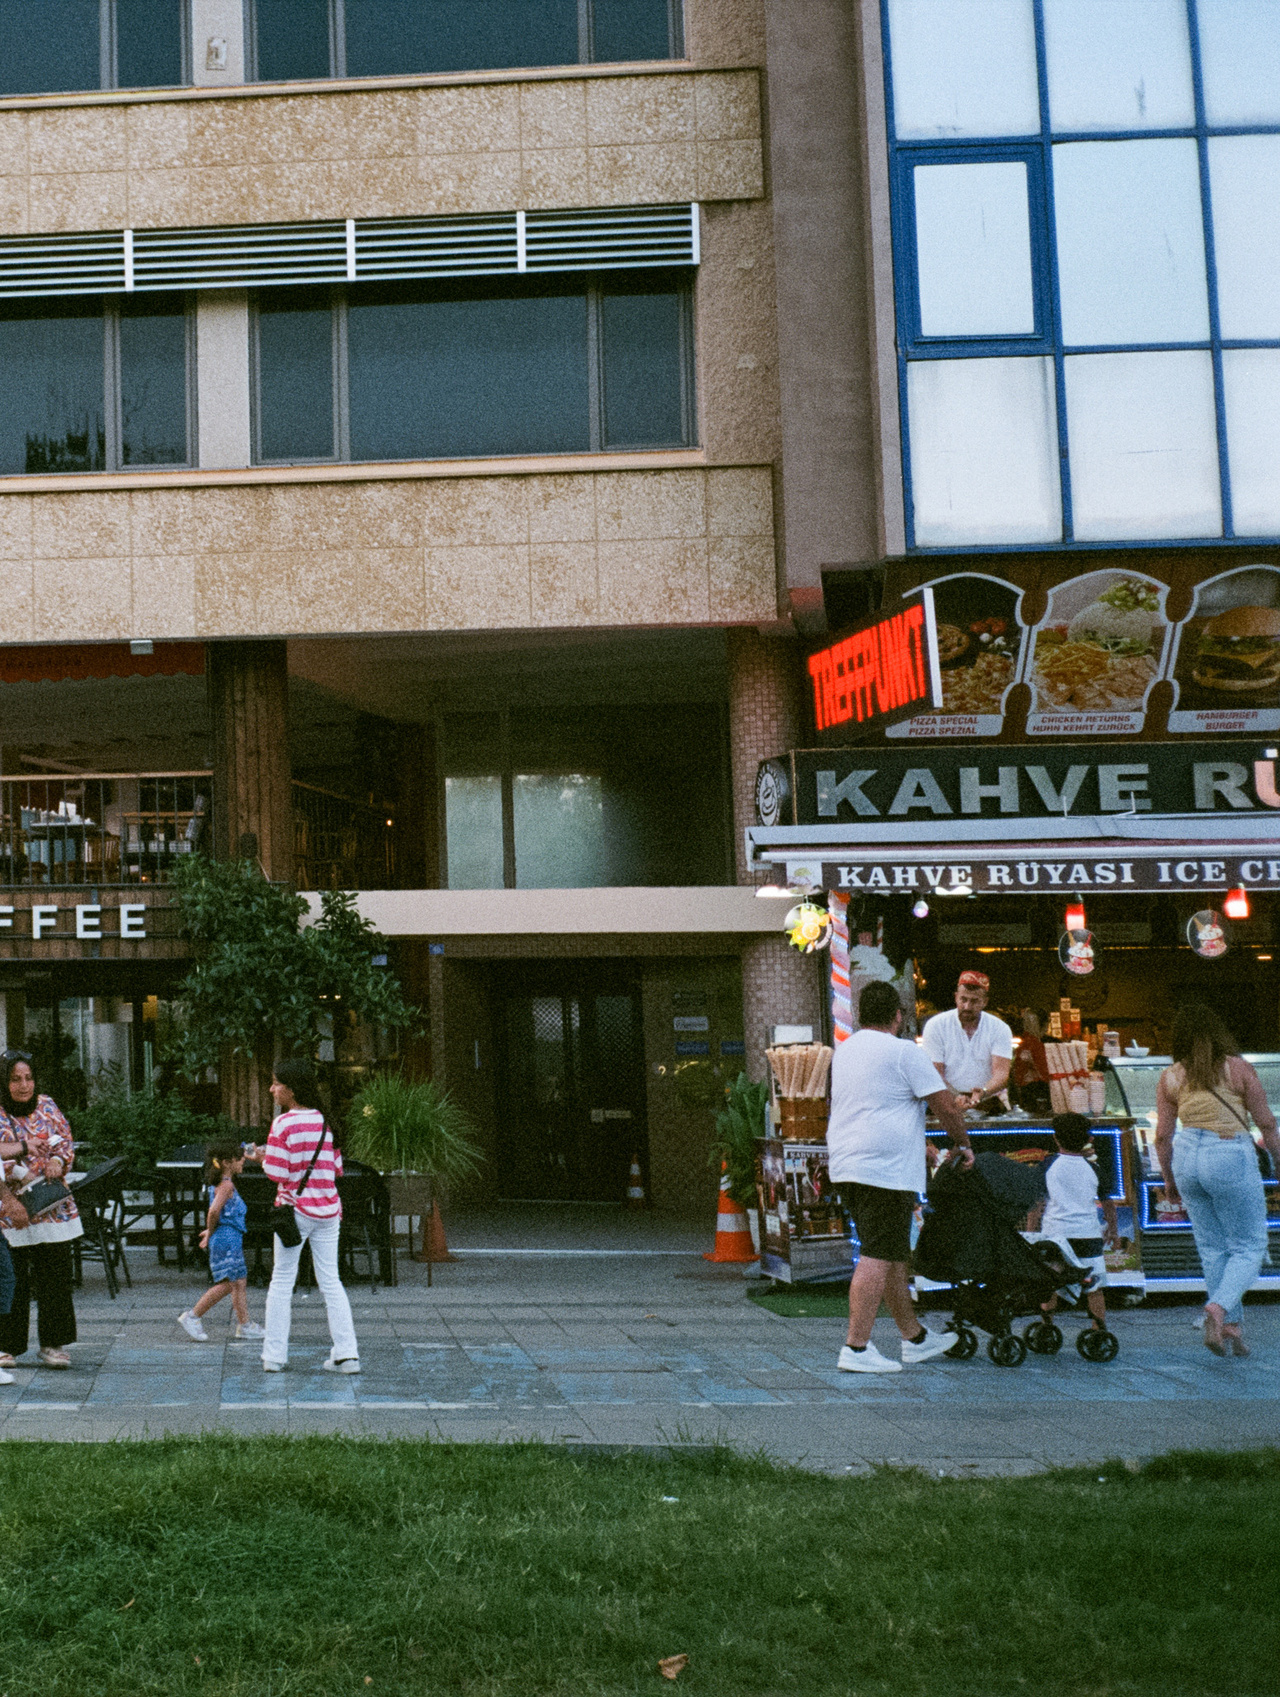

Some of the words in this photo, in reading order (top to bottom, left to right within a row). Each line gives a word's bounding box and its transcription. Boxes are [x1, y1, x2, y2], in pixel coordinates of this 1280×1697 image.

[808, 604, 926, 731] TREFFPUNKT
[910, 716, 937, 725] PIZZA
[940, 716, 979, 725] SPECIAL
[1041, 716, 1083, 724] CHICKEN
[1086, 715, 1131, 723] RETURNS
[1196, 711, 1259, 720] HAMBURGER
[1063, 724, 1094, 732] KEHRT
[1097, 722, 1136, 731] ZURÜCK
[1205, 721, 1246, 730] BURGER
[908, 727, 936, 736] PIZZA
[938, 726, 978, 735] SPEZIAL
[816, 763, 1153, 816] KAHVE
[837, 863, 973, 888] KAHVE
[987, 861, 1136, 885] RÜYASI
[1157, 861, 1227, 883] ICE
